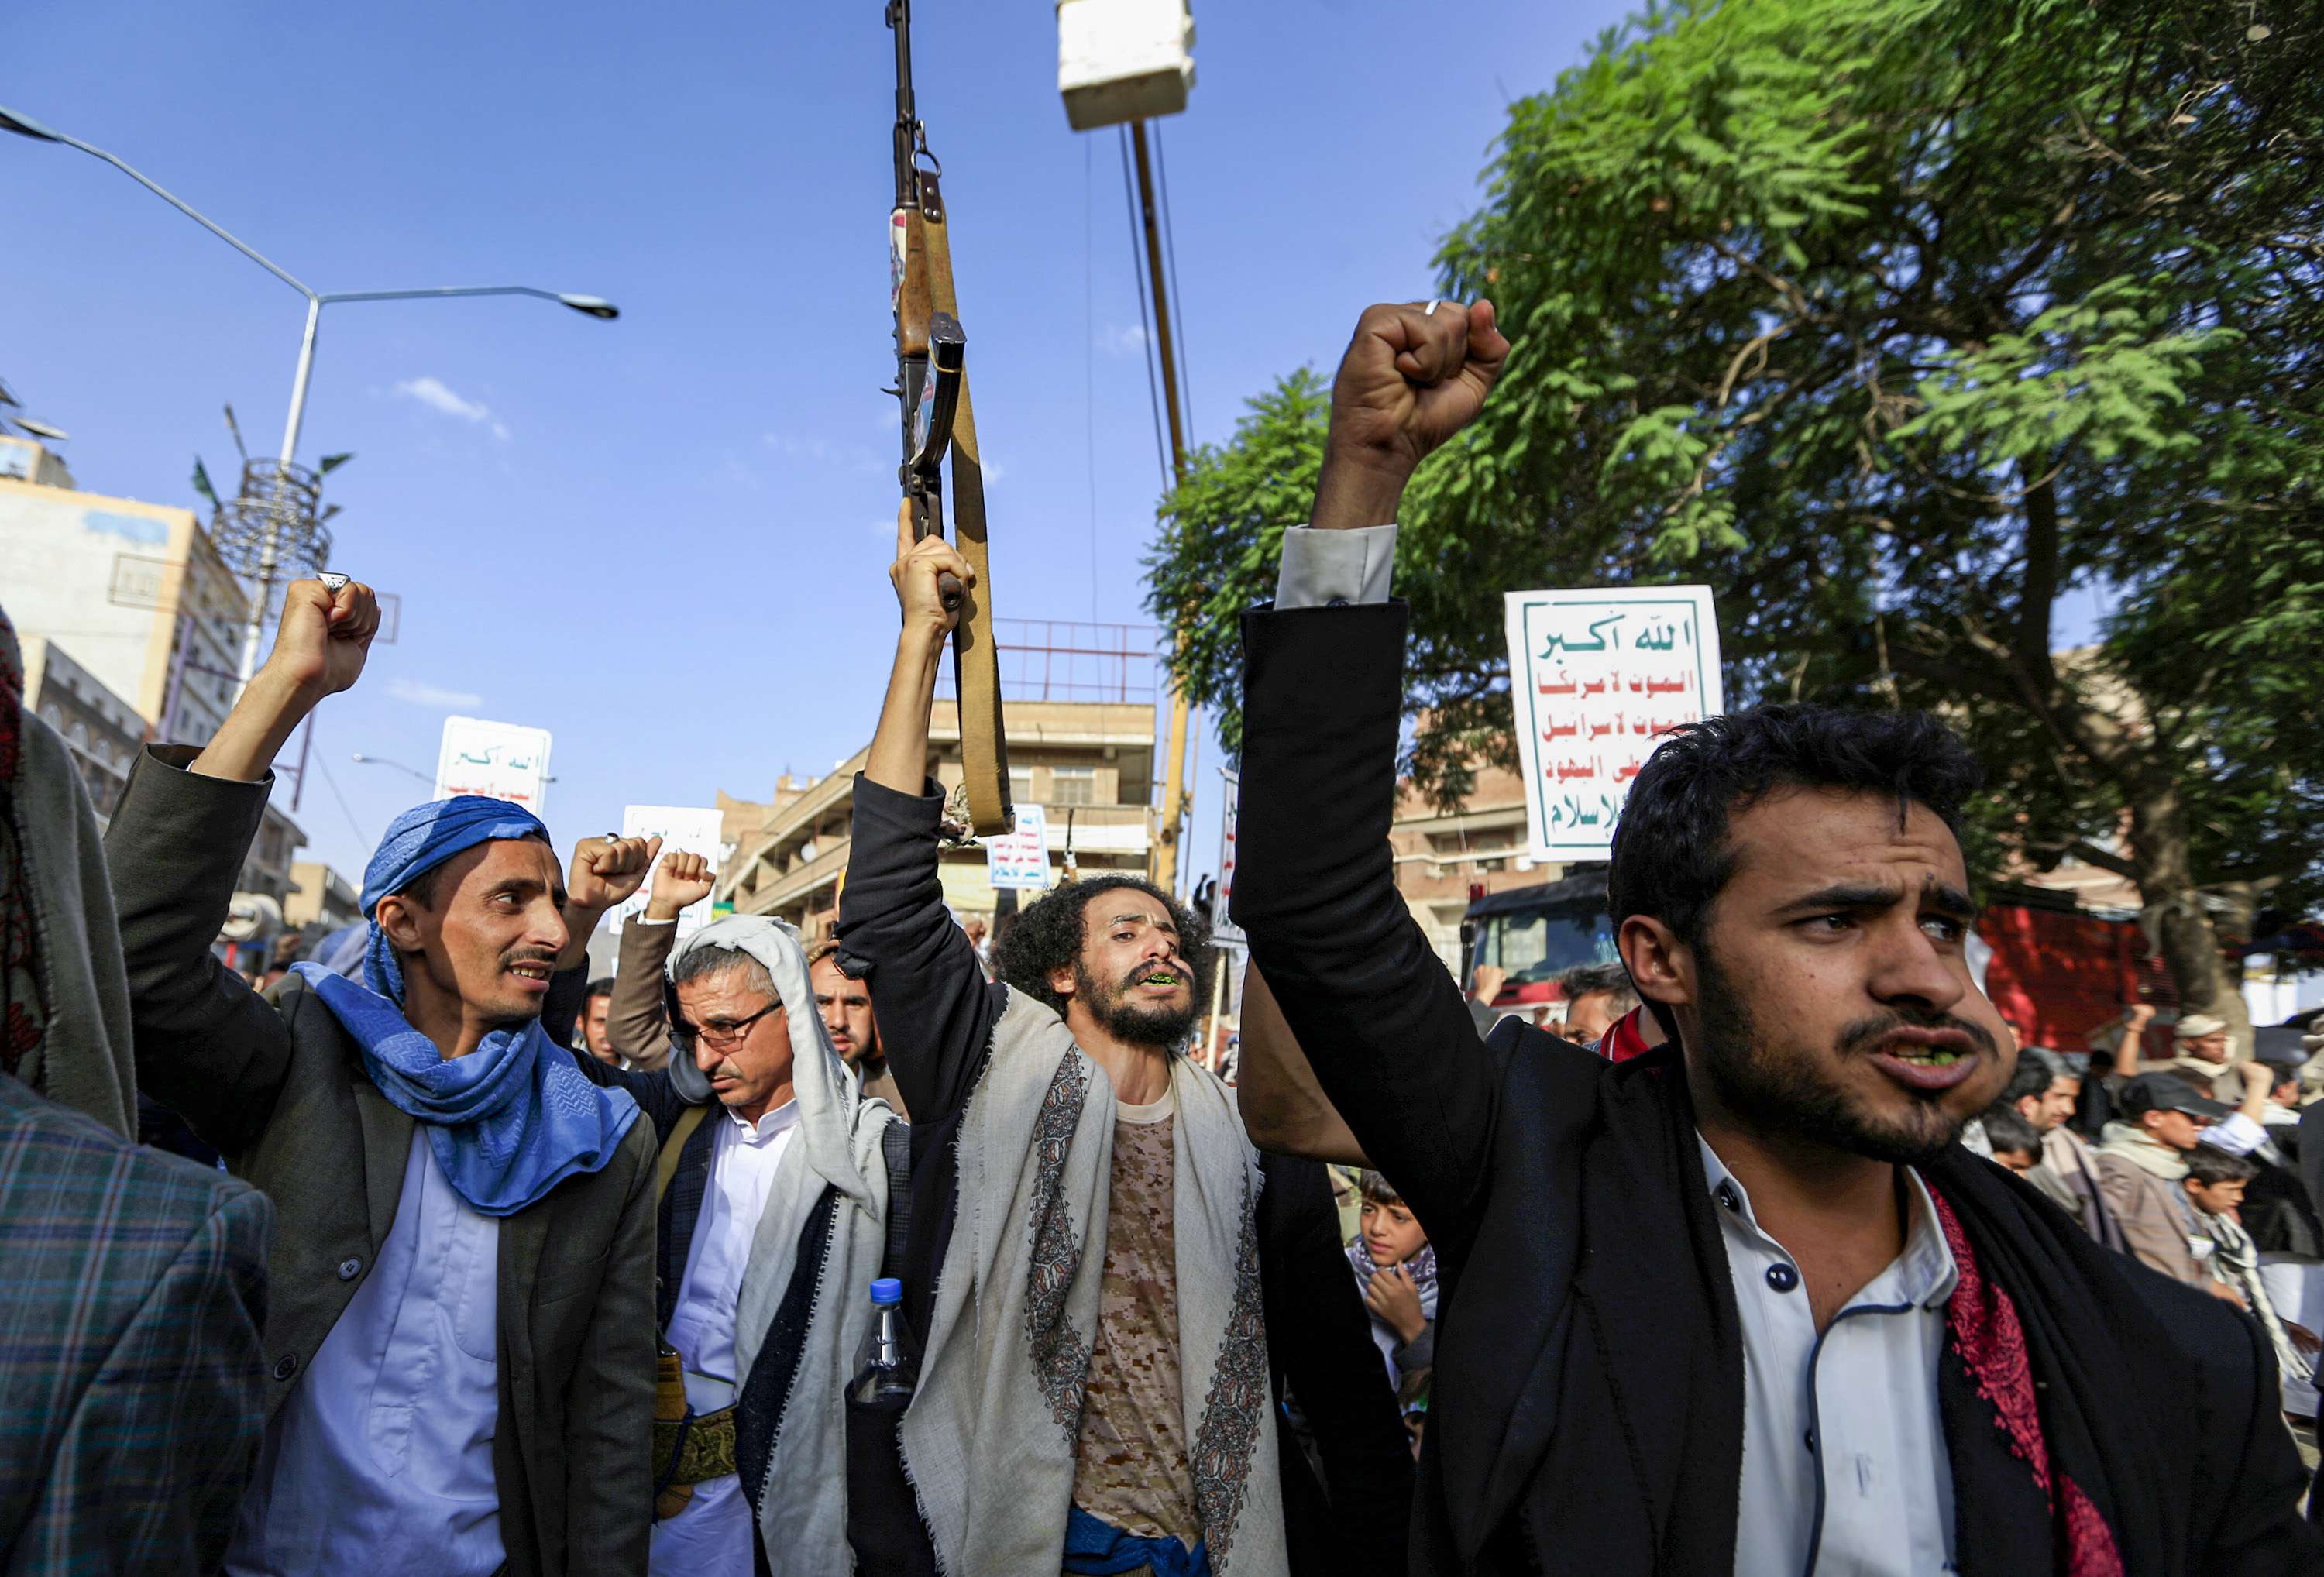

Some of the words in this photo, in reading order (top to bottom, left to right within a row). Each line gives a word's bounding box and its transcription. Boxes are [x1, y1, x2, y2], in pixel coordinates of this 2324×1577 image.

[1635, 614, 1690, 651] الله
[1629, 669, 1694, 699] الموت
[1545, 754, 1603, 785] اليهود
